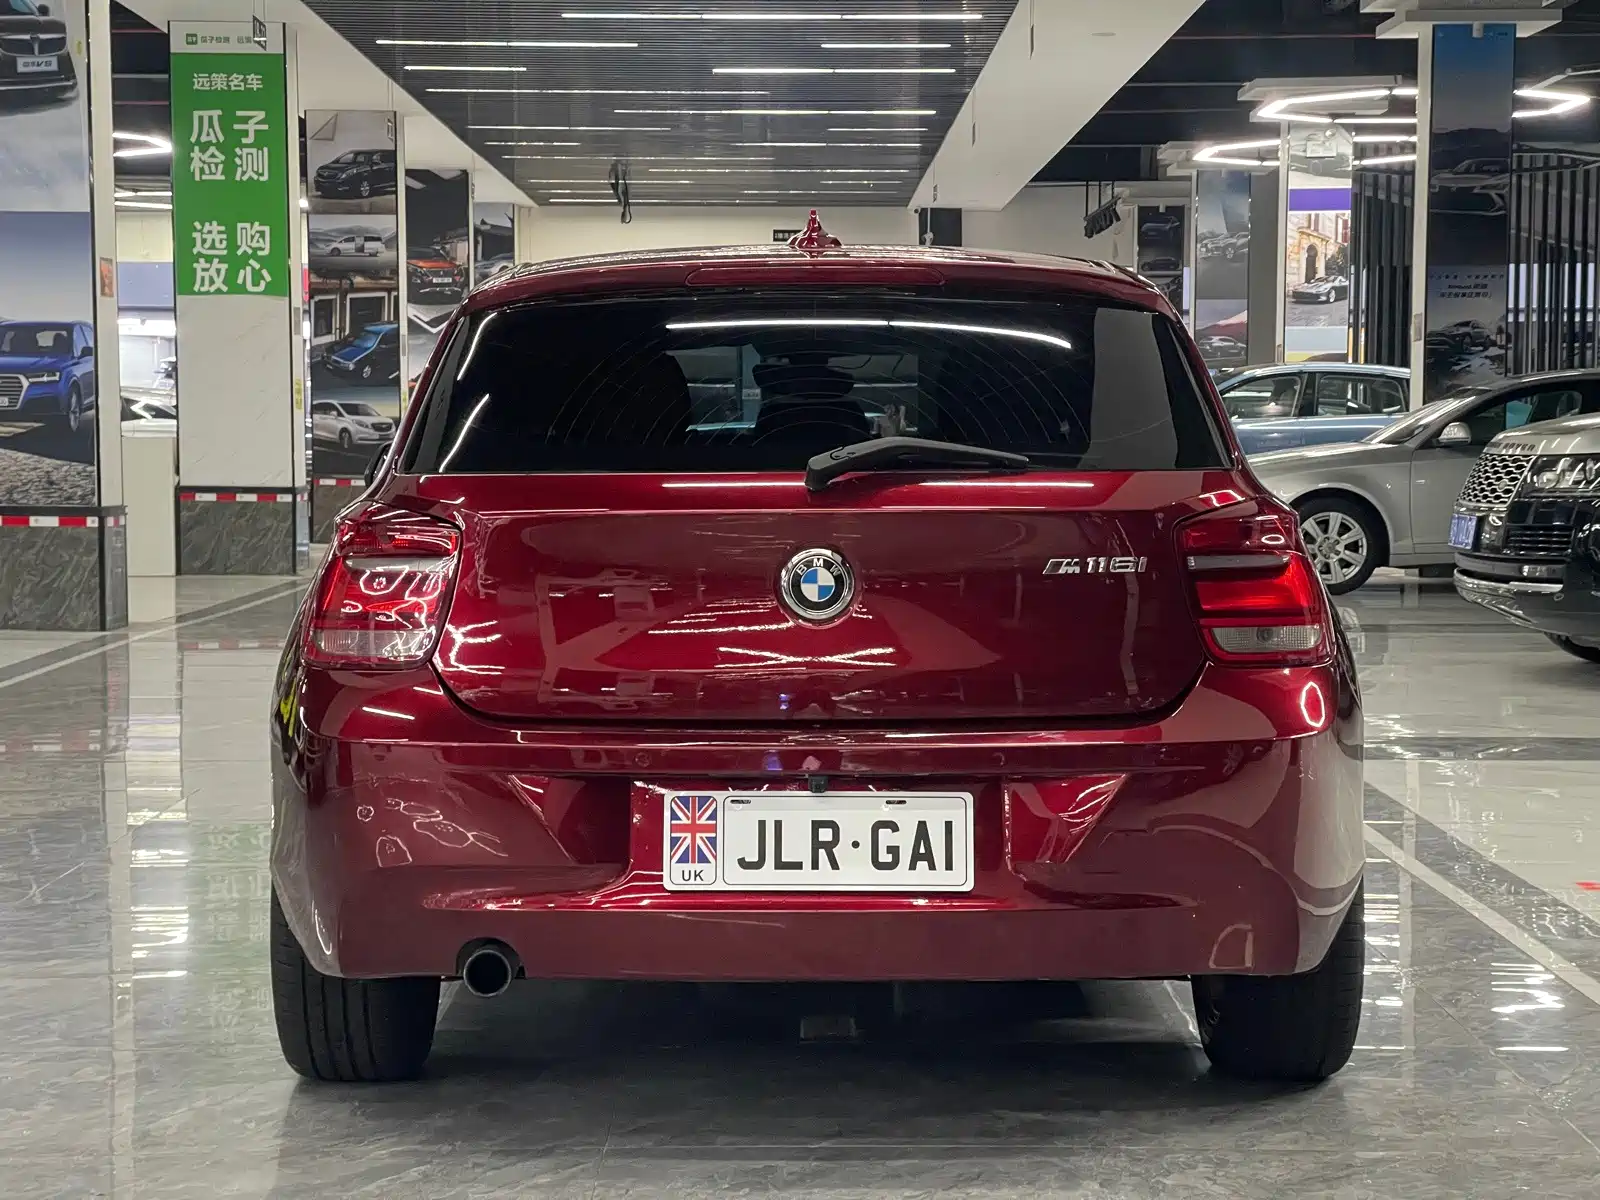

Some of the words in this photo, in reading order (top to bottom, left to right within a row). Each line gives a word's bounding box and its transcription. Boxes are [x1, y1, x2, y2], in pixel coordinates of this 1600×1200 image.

[193, 73, 263, 91] 远策名车
[190, 109, 269, 144] 瓜子
[190, 146, 269, 182] 检测
[192, 221, 271, 256] 选购
[192, 258, 272, 293] 放心
[796, 558, 840, 576] BMW
[682, 869, 704, 882] UK
